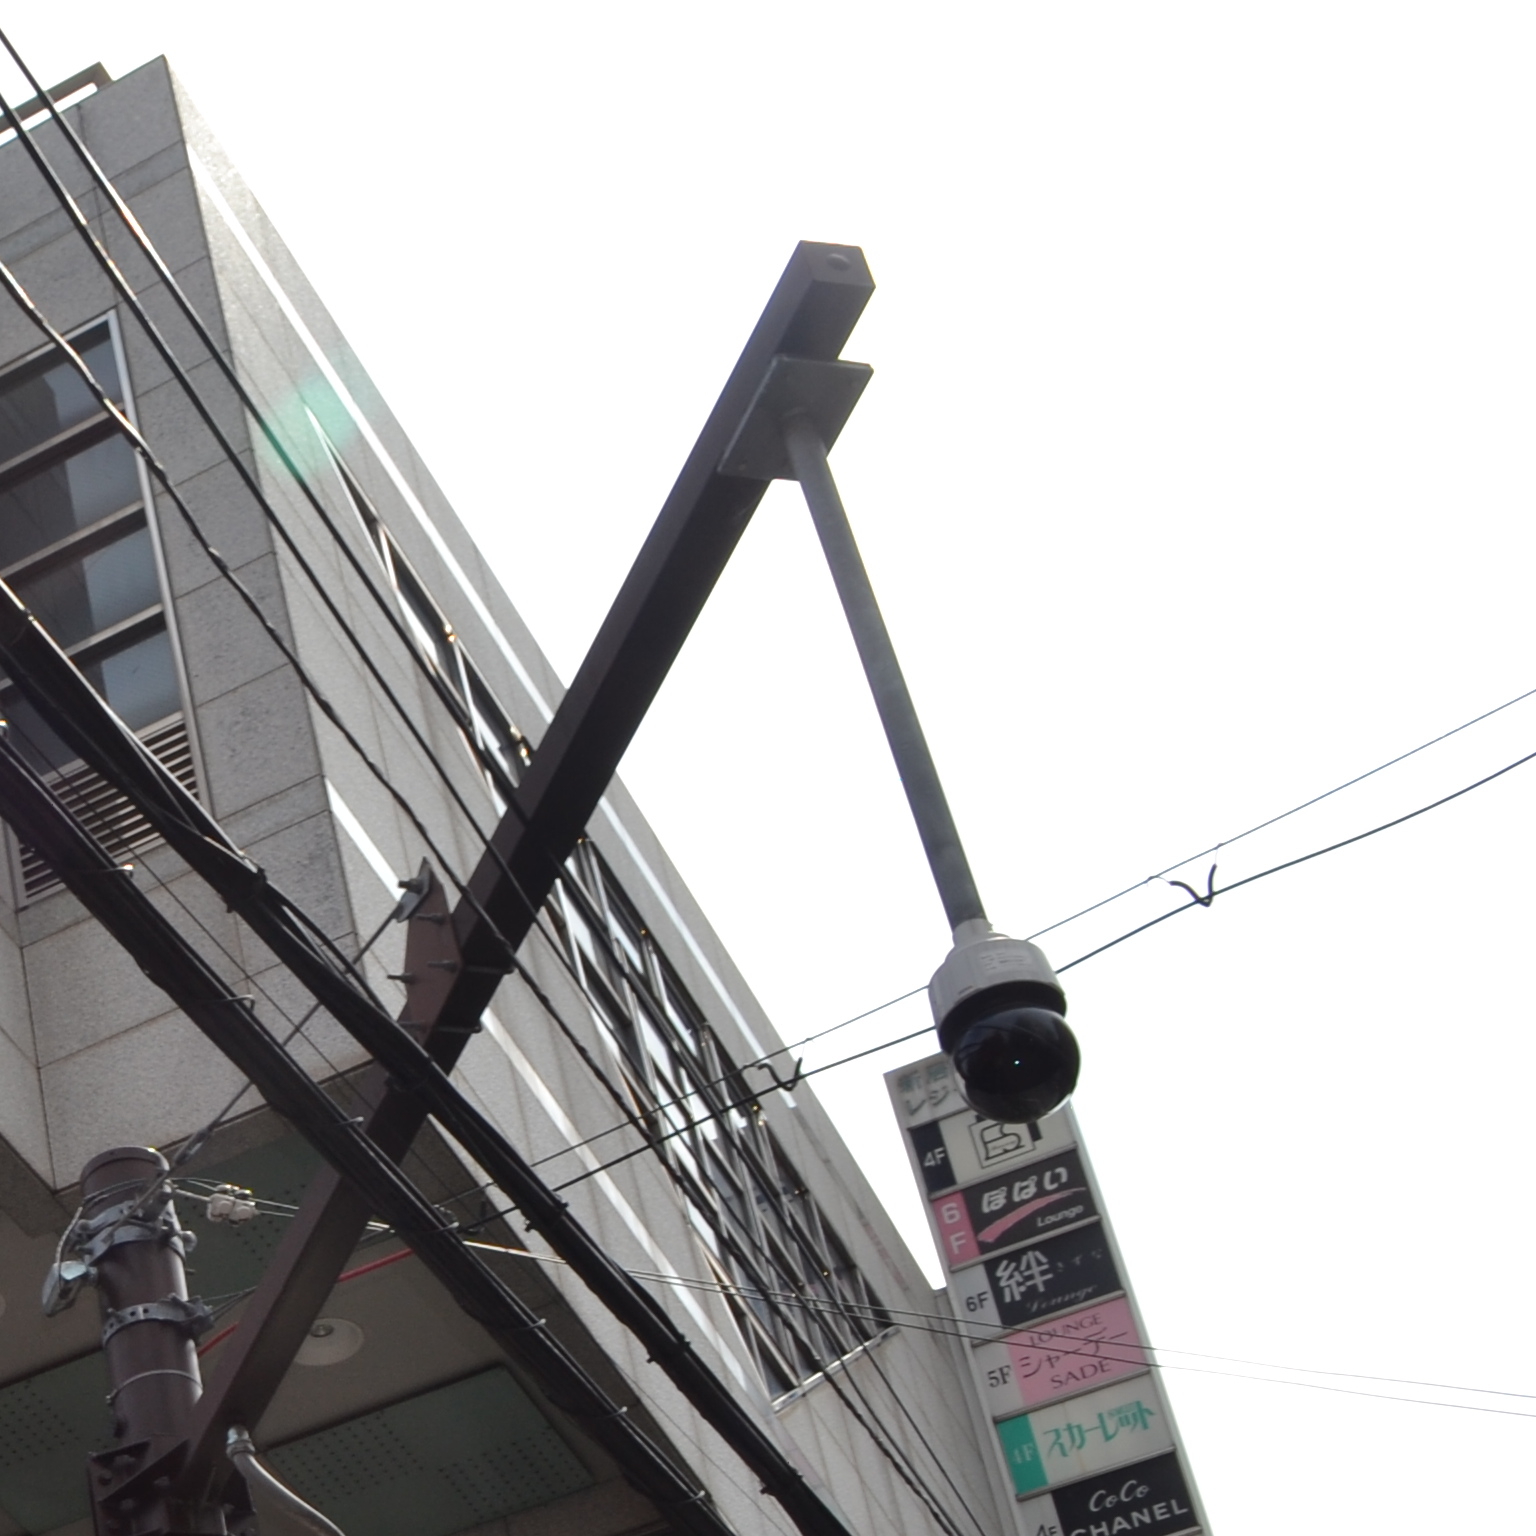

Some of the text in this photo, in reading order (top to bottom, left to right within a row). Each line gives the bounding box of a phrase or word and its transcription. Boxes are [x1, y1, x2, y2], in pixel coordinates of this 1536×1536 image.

[924, 1147, 945, 1168] 4F
[1036, 1205, 1084, 1227] Lounge
[995, 1251, 1054, 1303] 絆
[965, 1291, 989, 1313] 6F
[1029, 1313, 1104, 1347] LOUNGE
[1020, 1327, 1128, 1379] シャーデー
[986, 1365, 1012, 1389] 5F
[1050, 1358, 1112, 1390] SADE
[1043, 1400, 1156, 1459] スカーレット
